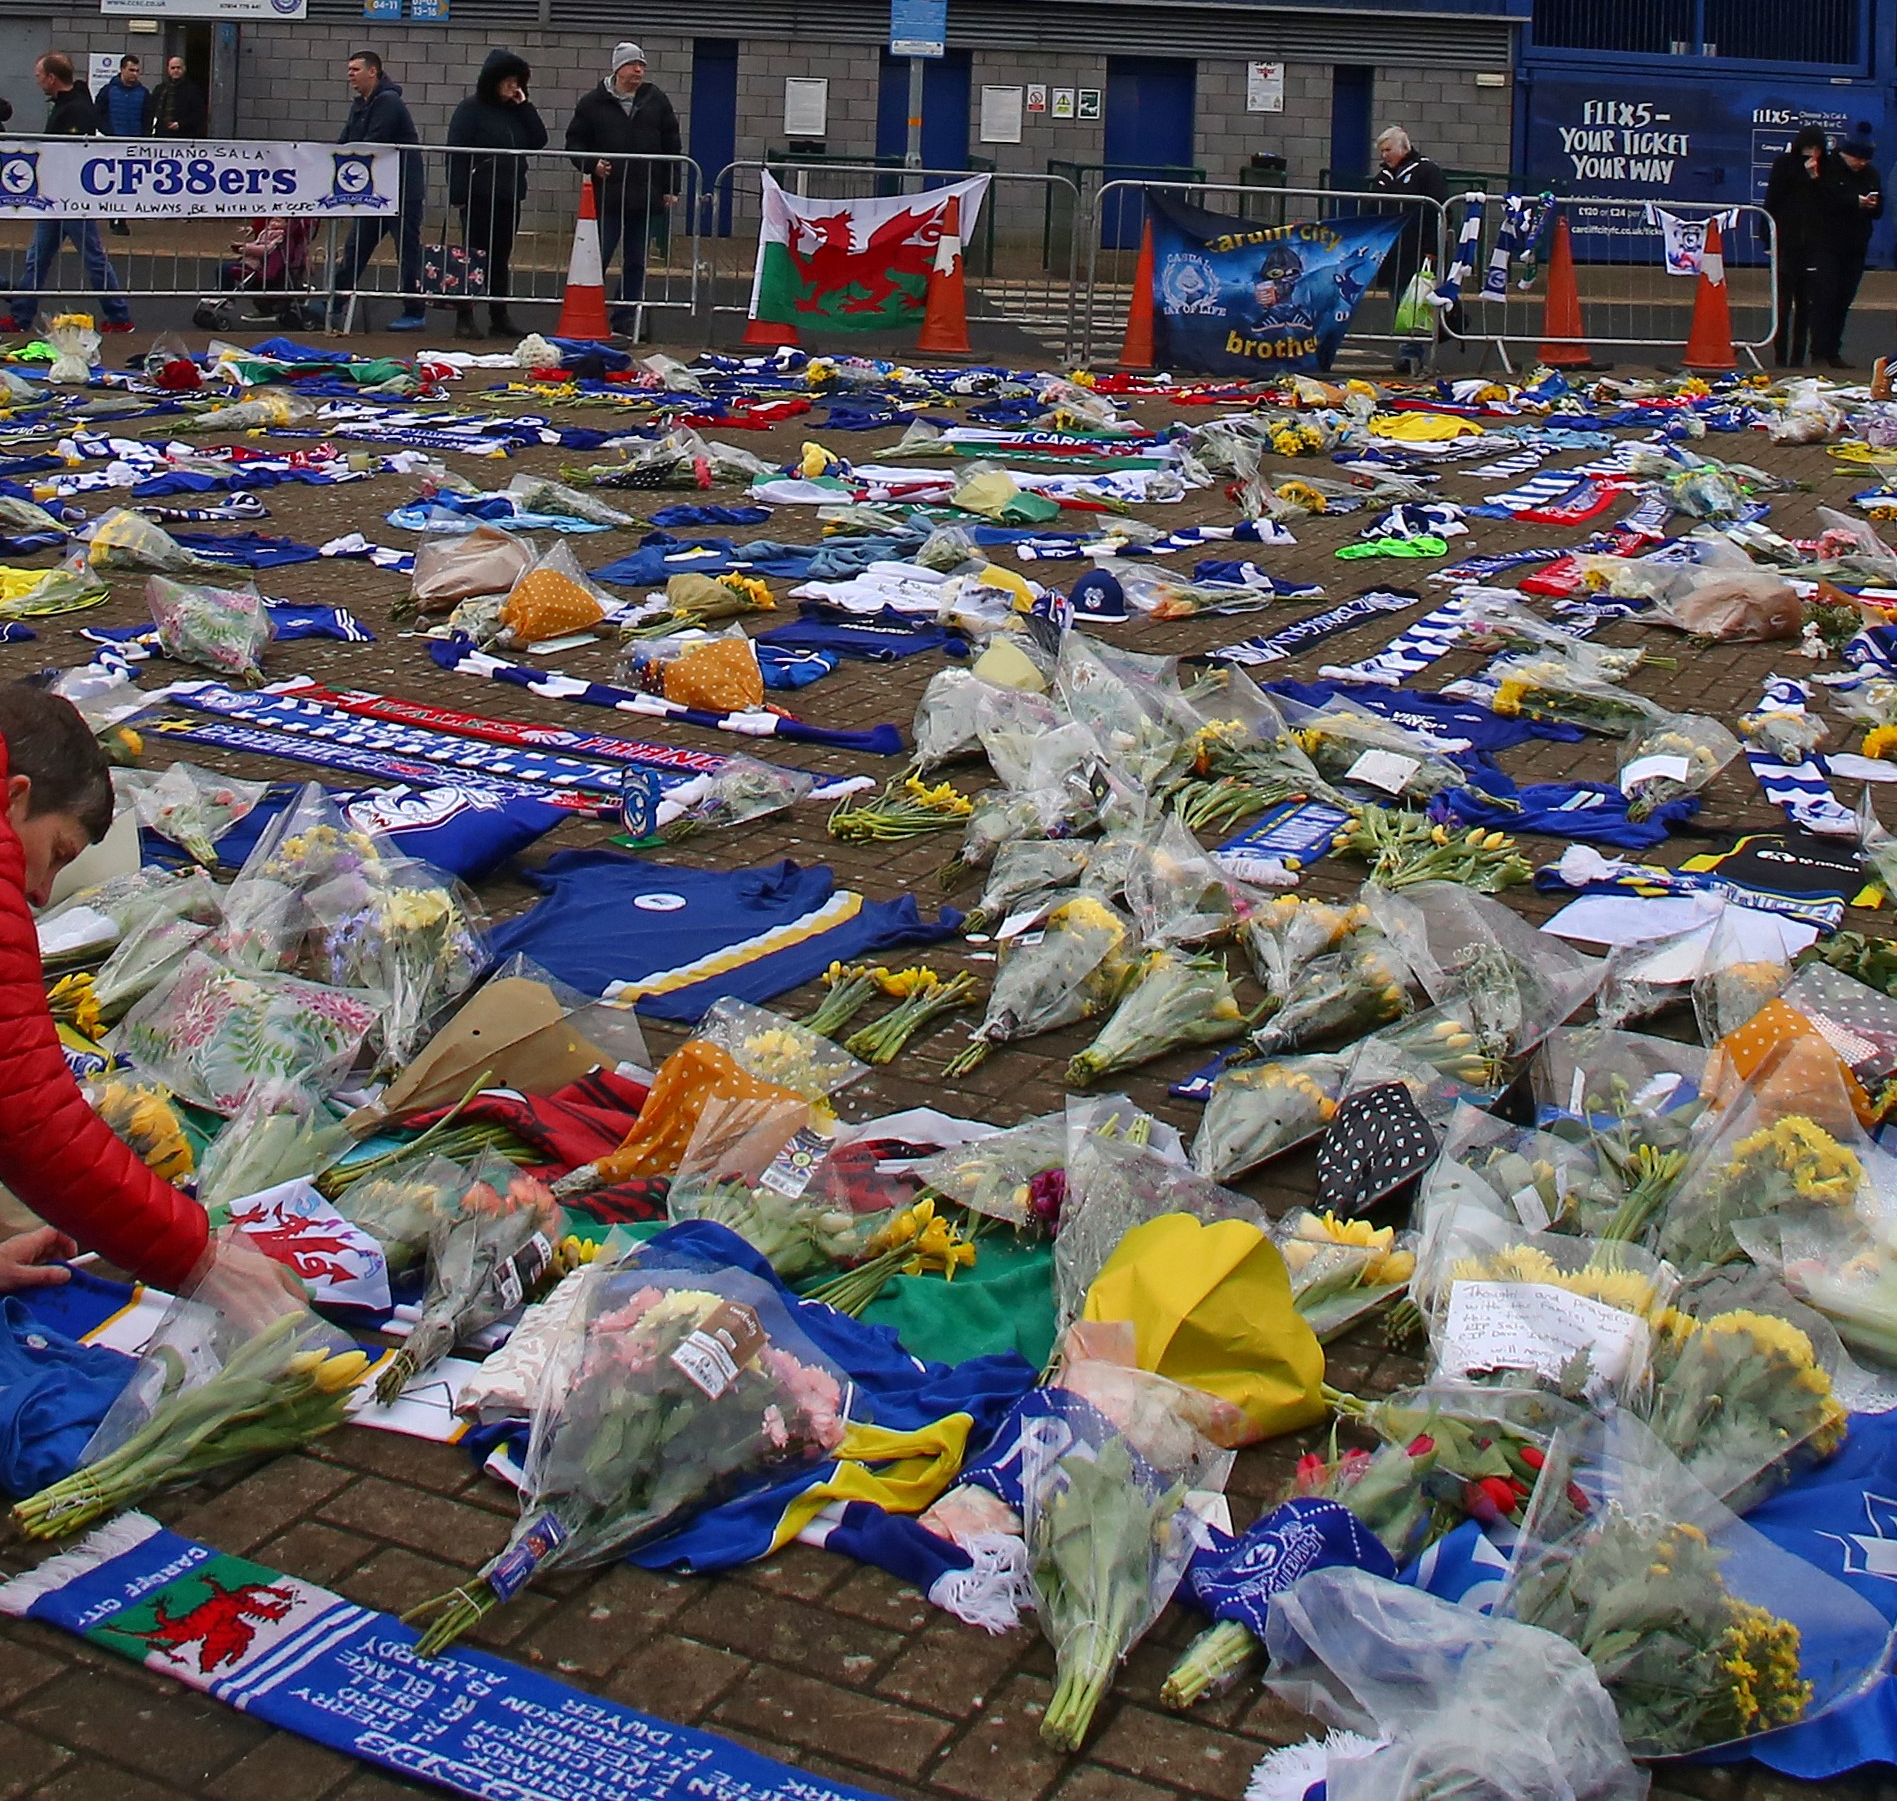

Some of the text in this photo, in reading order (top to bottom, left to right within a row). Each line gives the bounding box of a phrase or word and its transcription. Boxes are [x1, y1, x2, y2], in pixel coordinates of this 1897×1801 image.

[125, 144, 207, 159] EMILIANO
[1559, 127, 1690, 157] YOUR TICKET
[79, 158, 297, 196] CF38ers
[1570, 155, 1674, 185] YOUR WAY
[98, 200, 128, 213] WILL
[134, 202, 182, 214] ALWAYS
[190, 202, 208, 215] BE
[215, 202, 245, 214] WITH
[251, 204, 266, 213] US
[272, 202, 282, 212] AT
[1299, 223, 1344, 252] city
[1200, 302, 1227, 317] LIFE
[367, 699, 526, 736] WALES
[124, 1546, 209, 1598] CARDIFF
